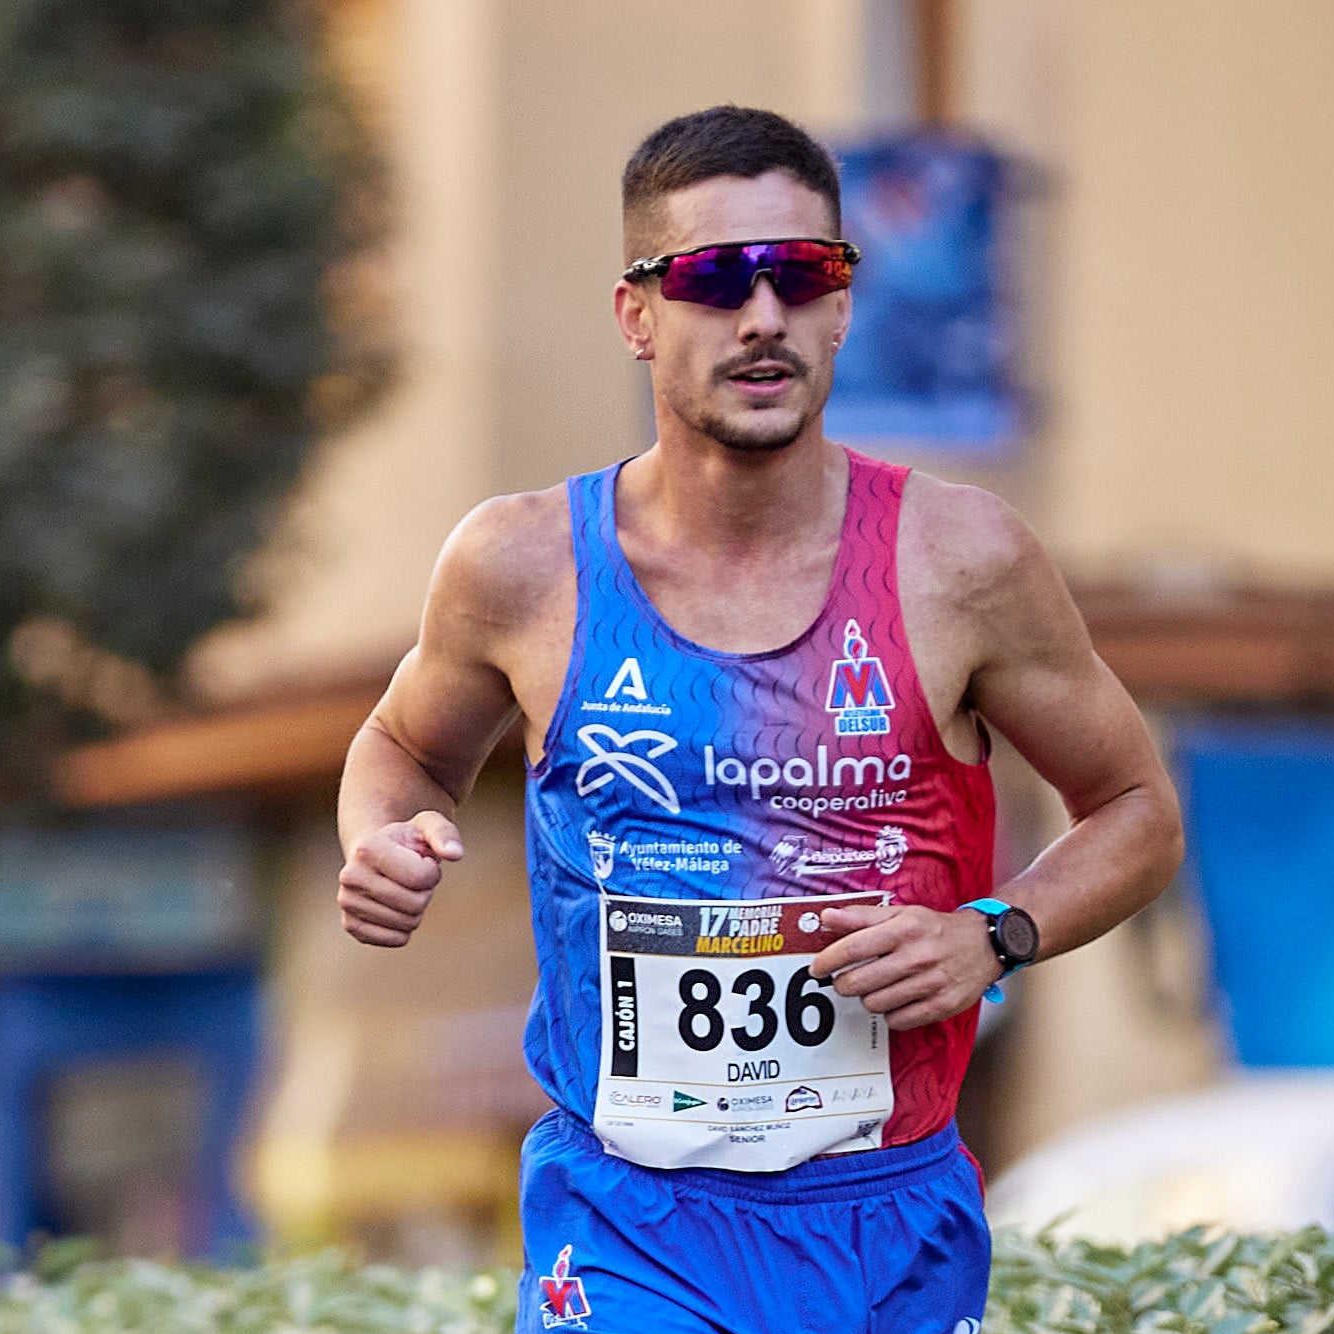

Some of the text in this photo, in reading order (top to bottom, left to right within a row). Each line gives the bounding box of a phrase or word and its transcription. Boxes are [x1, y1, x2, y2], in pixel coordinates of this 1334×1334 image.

[609, 702, 622, 712] de
[704, 745, 912, 800] lapalma
[770, 789, 907, 818] cooperativa
[619, 840, 742, 857] Ayuntamiento de
[631, 857, 729, 874] Vélez-Málaga
[628, 912, 683, 927] OXIMESA
[728, 905, 783, 919] MEMORIAL
[700, 907, 731, 937] 17
[729, 918, 779, 937] PADRE
[696, 934, 784, 953] MARCELINO
[615, 980, 635, 1051] CAJÓN 1
[678, 965, 835, 1051] 836
[728, 1059, 781, 1082] DAVID
